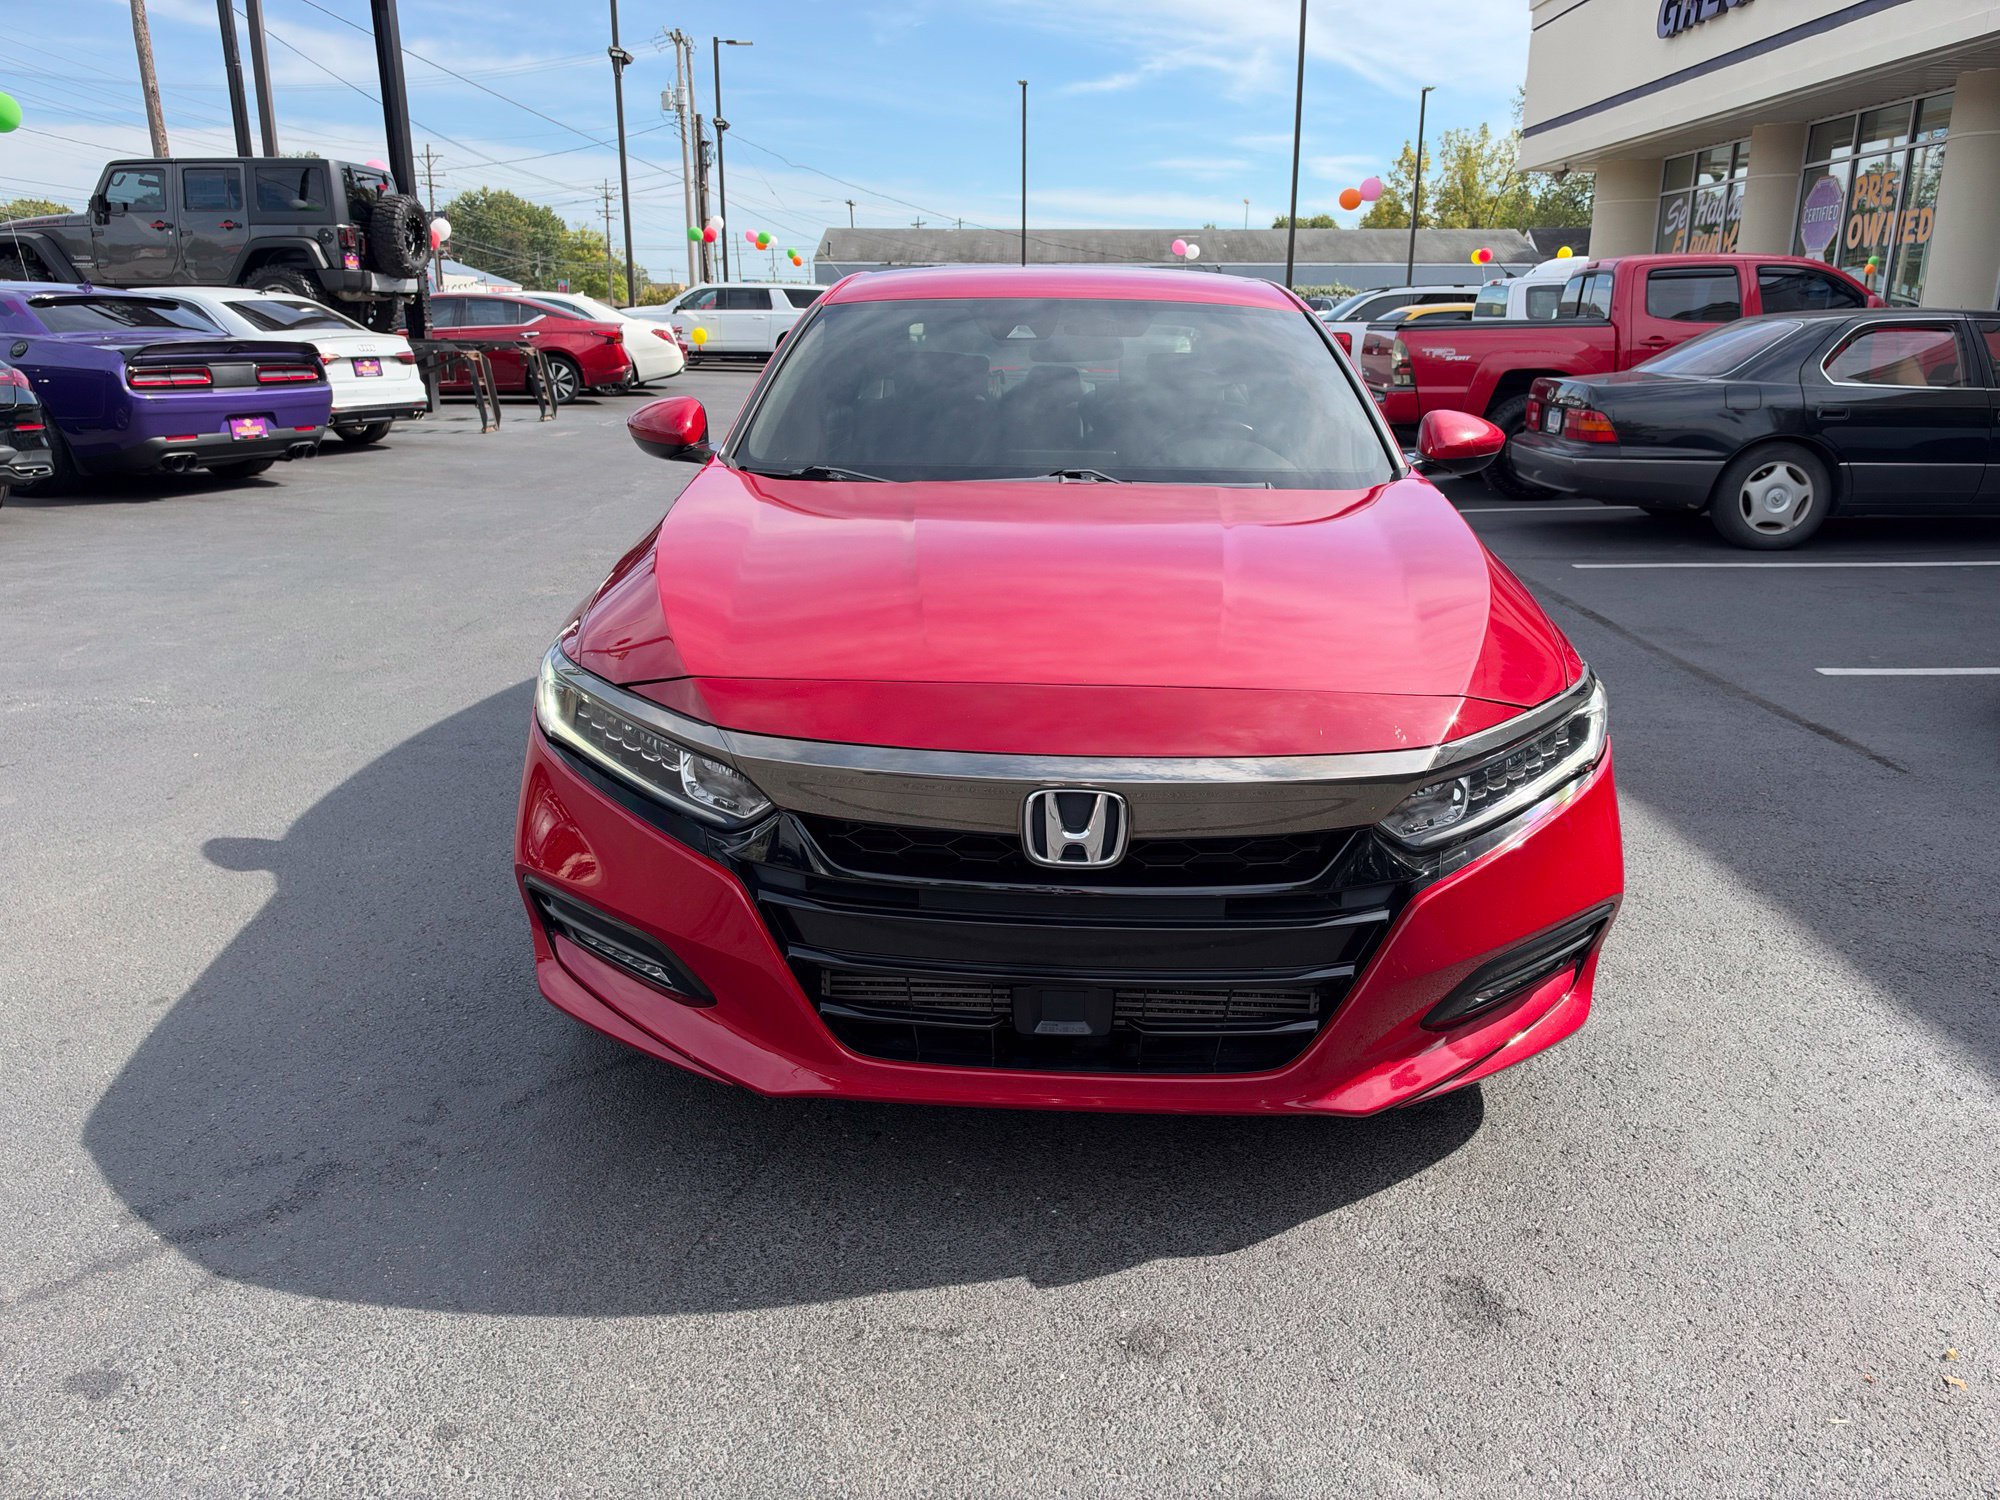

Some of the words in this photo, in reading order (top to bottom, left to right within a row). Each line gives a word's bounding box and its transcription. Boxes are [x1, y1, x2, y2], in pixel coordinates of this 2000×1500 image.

[1664, 198, 1688, 235] Se
[1803, 204, 1839, 223] CERTIFIED
[1847, 207, 1933, 249] OWNED
